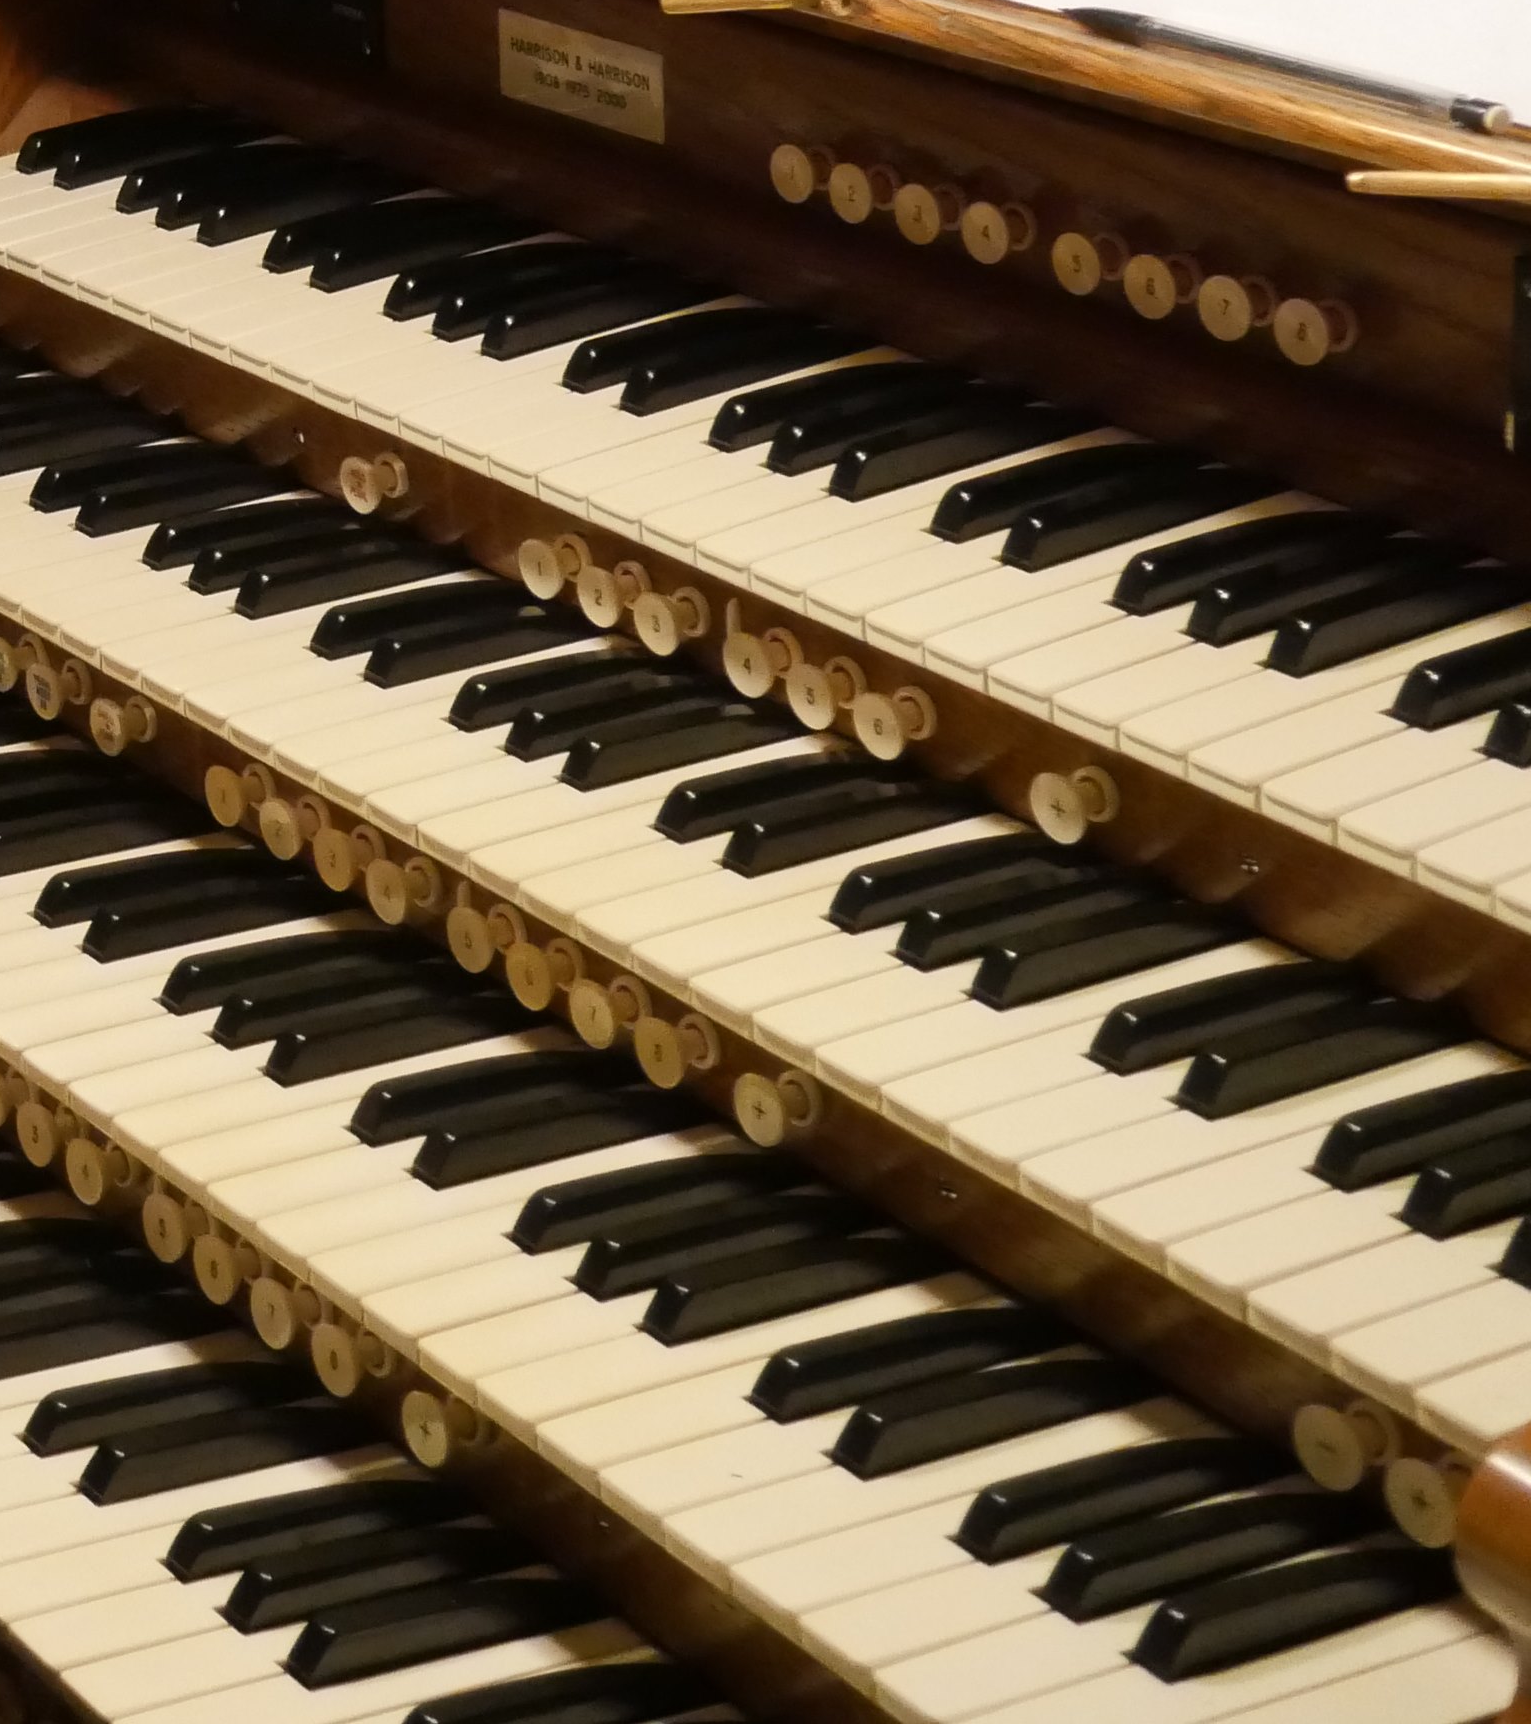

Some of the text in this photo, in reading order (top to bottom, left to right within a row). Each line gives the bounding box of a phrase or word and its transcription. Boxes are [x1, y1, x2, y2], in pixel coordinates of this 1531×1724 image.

[509, 36, 651, 91] HARRISON & HARRISON
[982, 225, 991, 240] 4
[743, 656, 751, 674] 4
[807, 685, 815, 704] 5
